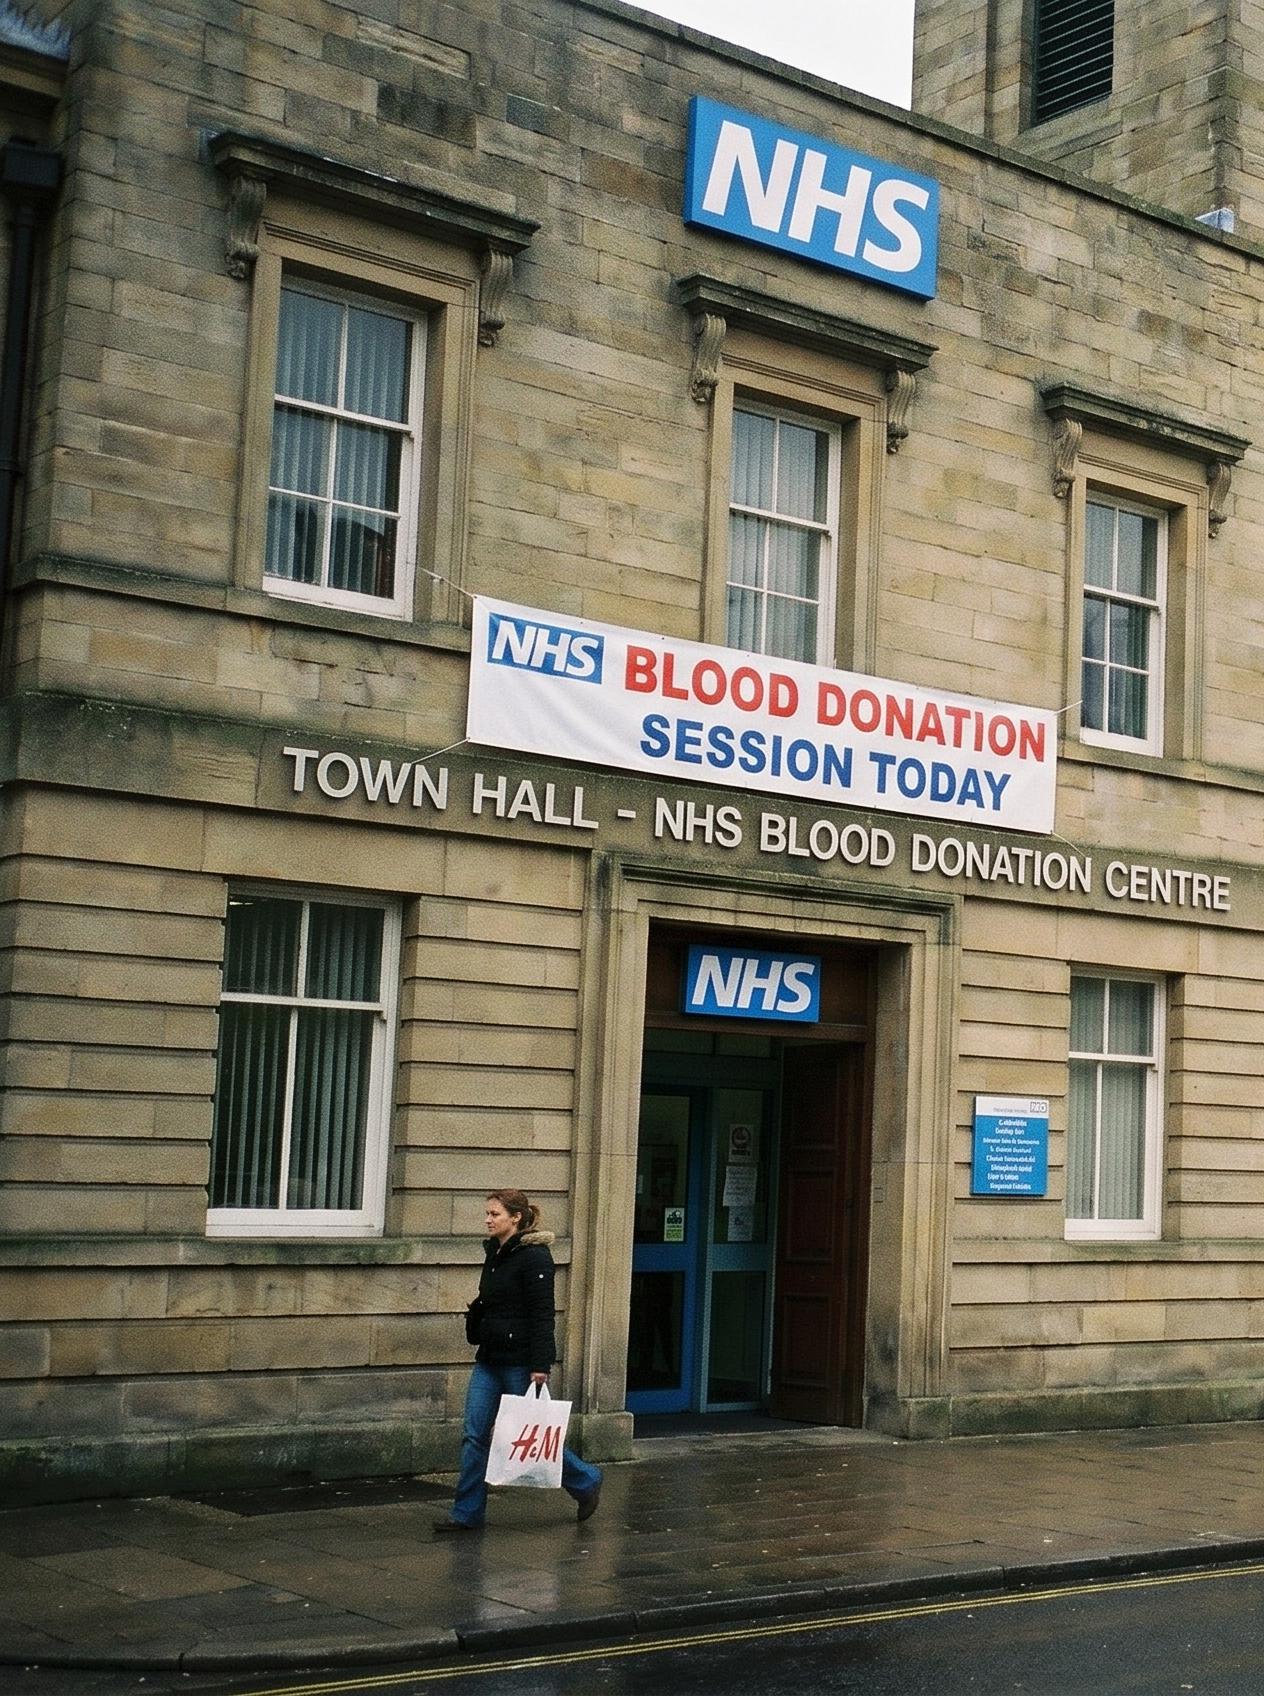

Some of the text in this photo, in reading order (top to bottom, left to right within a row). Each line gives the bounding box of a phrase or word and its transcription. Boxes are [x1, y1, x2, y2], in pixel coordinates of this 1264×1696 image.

[702, 120, 930, 272] NHS
[491, 620, 598, 677] NHS
[625, 644, 1045, 762] BLOOD DONATION
[640, 714, 1011, 811] SESSION TODAY
[283, 747, 448, 810] TOWN
[472, 773, 599, 829] HALL
[654, 797, 743, 848] NHS
[760, 812, 896, 867] BLOOD
[911, 833, 1092, 893] DONATION
[1105, 861, 1232, 911] CENTRE
[691, 954, 816, 1013] NHS
[509, 1424, 561, 1463] H&M
